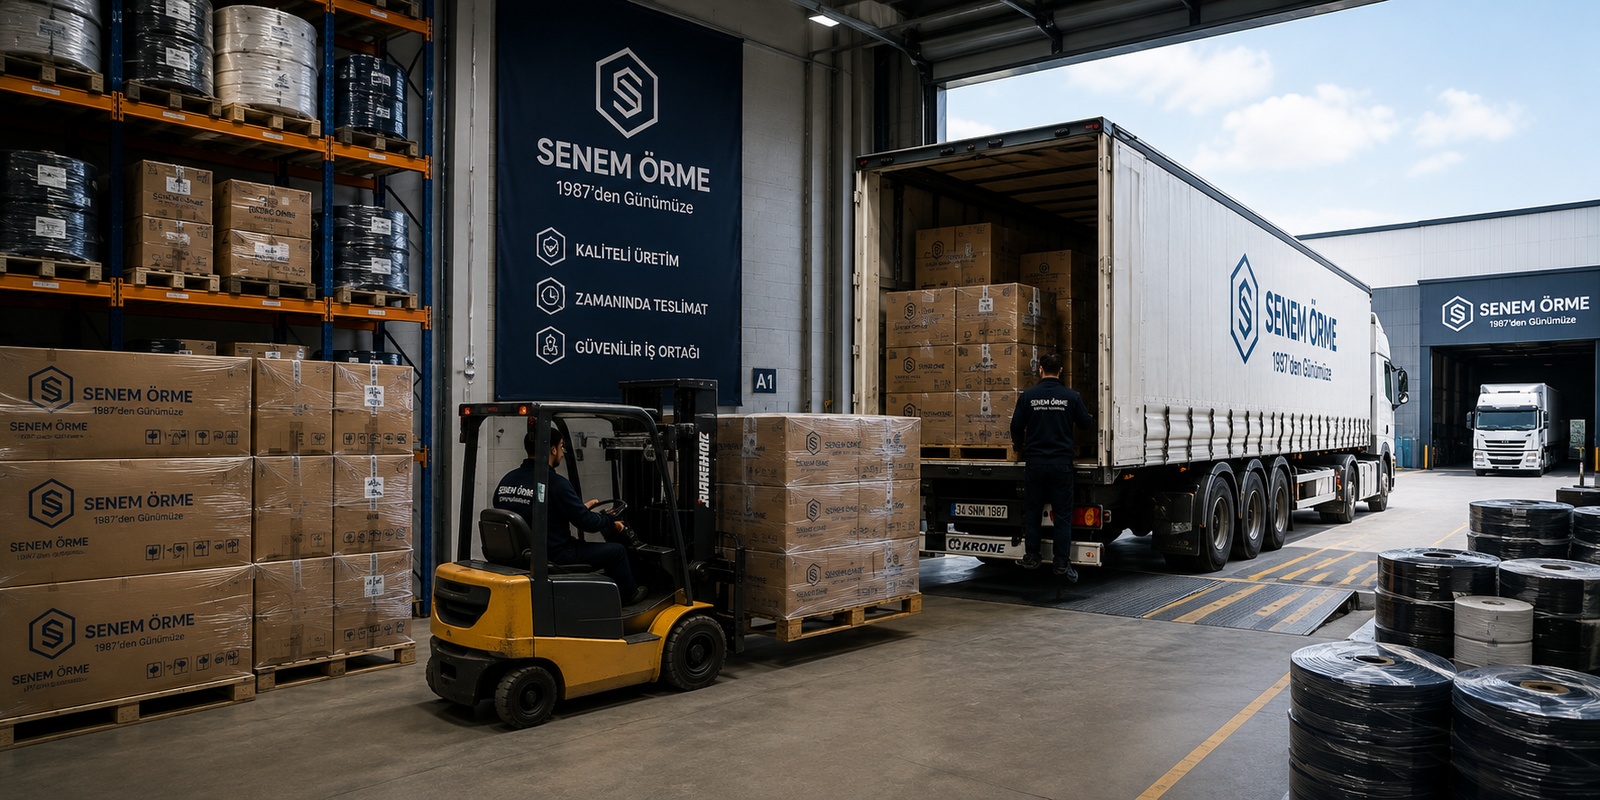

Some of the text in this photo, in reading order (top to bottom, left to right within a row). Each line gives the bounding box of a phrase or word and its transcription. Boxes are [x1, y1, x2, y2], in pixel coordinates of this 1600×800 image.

[536, 137, 711, 193] SENEM ÖRME
[556, 180, 694, 214] 1987'den Günümüze
[575, 243, 680, 267] KALİTELİ ÜRETİM
[575, 292, 708, 315] ZAMANINDA TESLİMAT
[1479, 295, 1590, 317] SENEM ÖRME
[1265, 290, 1337, 352] SENEM ÖRME
[1528, 316, 1577, 326] Günümüze
[574, 338, 700, 360] GÜVENİLİR İŞ ORTAĞI
[755, 373, 773, 390] A1
[83, 385, 193, 404] SENEM ÖRME
[92, 406, 184, 417] 1987'den Günümüze
[9, 419, 88, 432] SENEM ÖRME
[84, 491, 194, 511] SENEM ÖRME
[968, 505, 986, 517] SNM
[93, 512, 184, 525] 1987'den Günümüze
[10, 536, 89, 553] SENEM ÖRME
[962, 541, 1006, 554] KRONE
[85, 613, 195, 640] SENEM ÖRME
[95, 633, 185, 653] 1987'den Günümüze
[12, 669, 53, 686] SENEM
[56, 663, 90, 677] ÖRME
